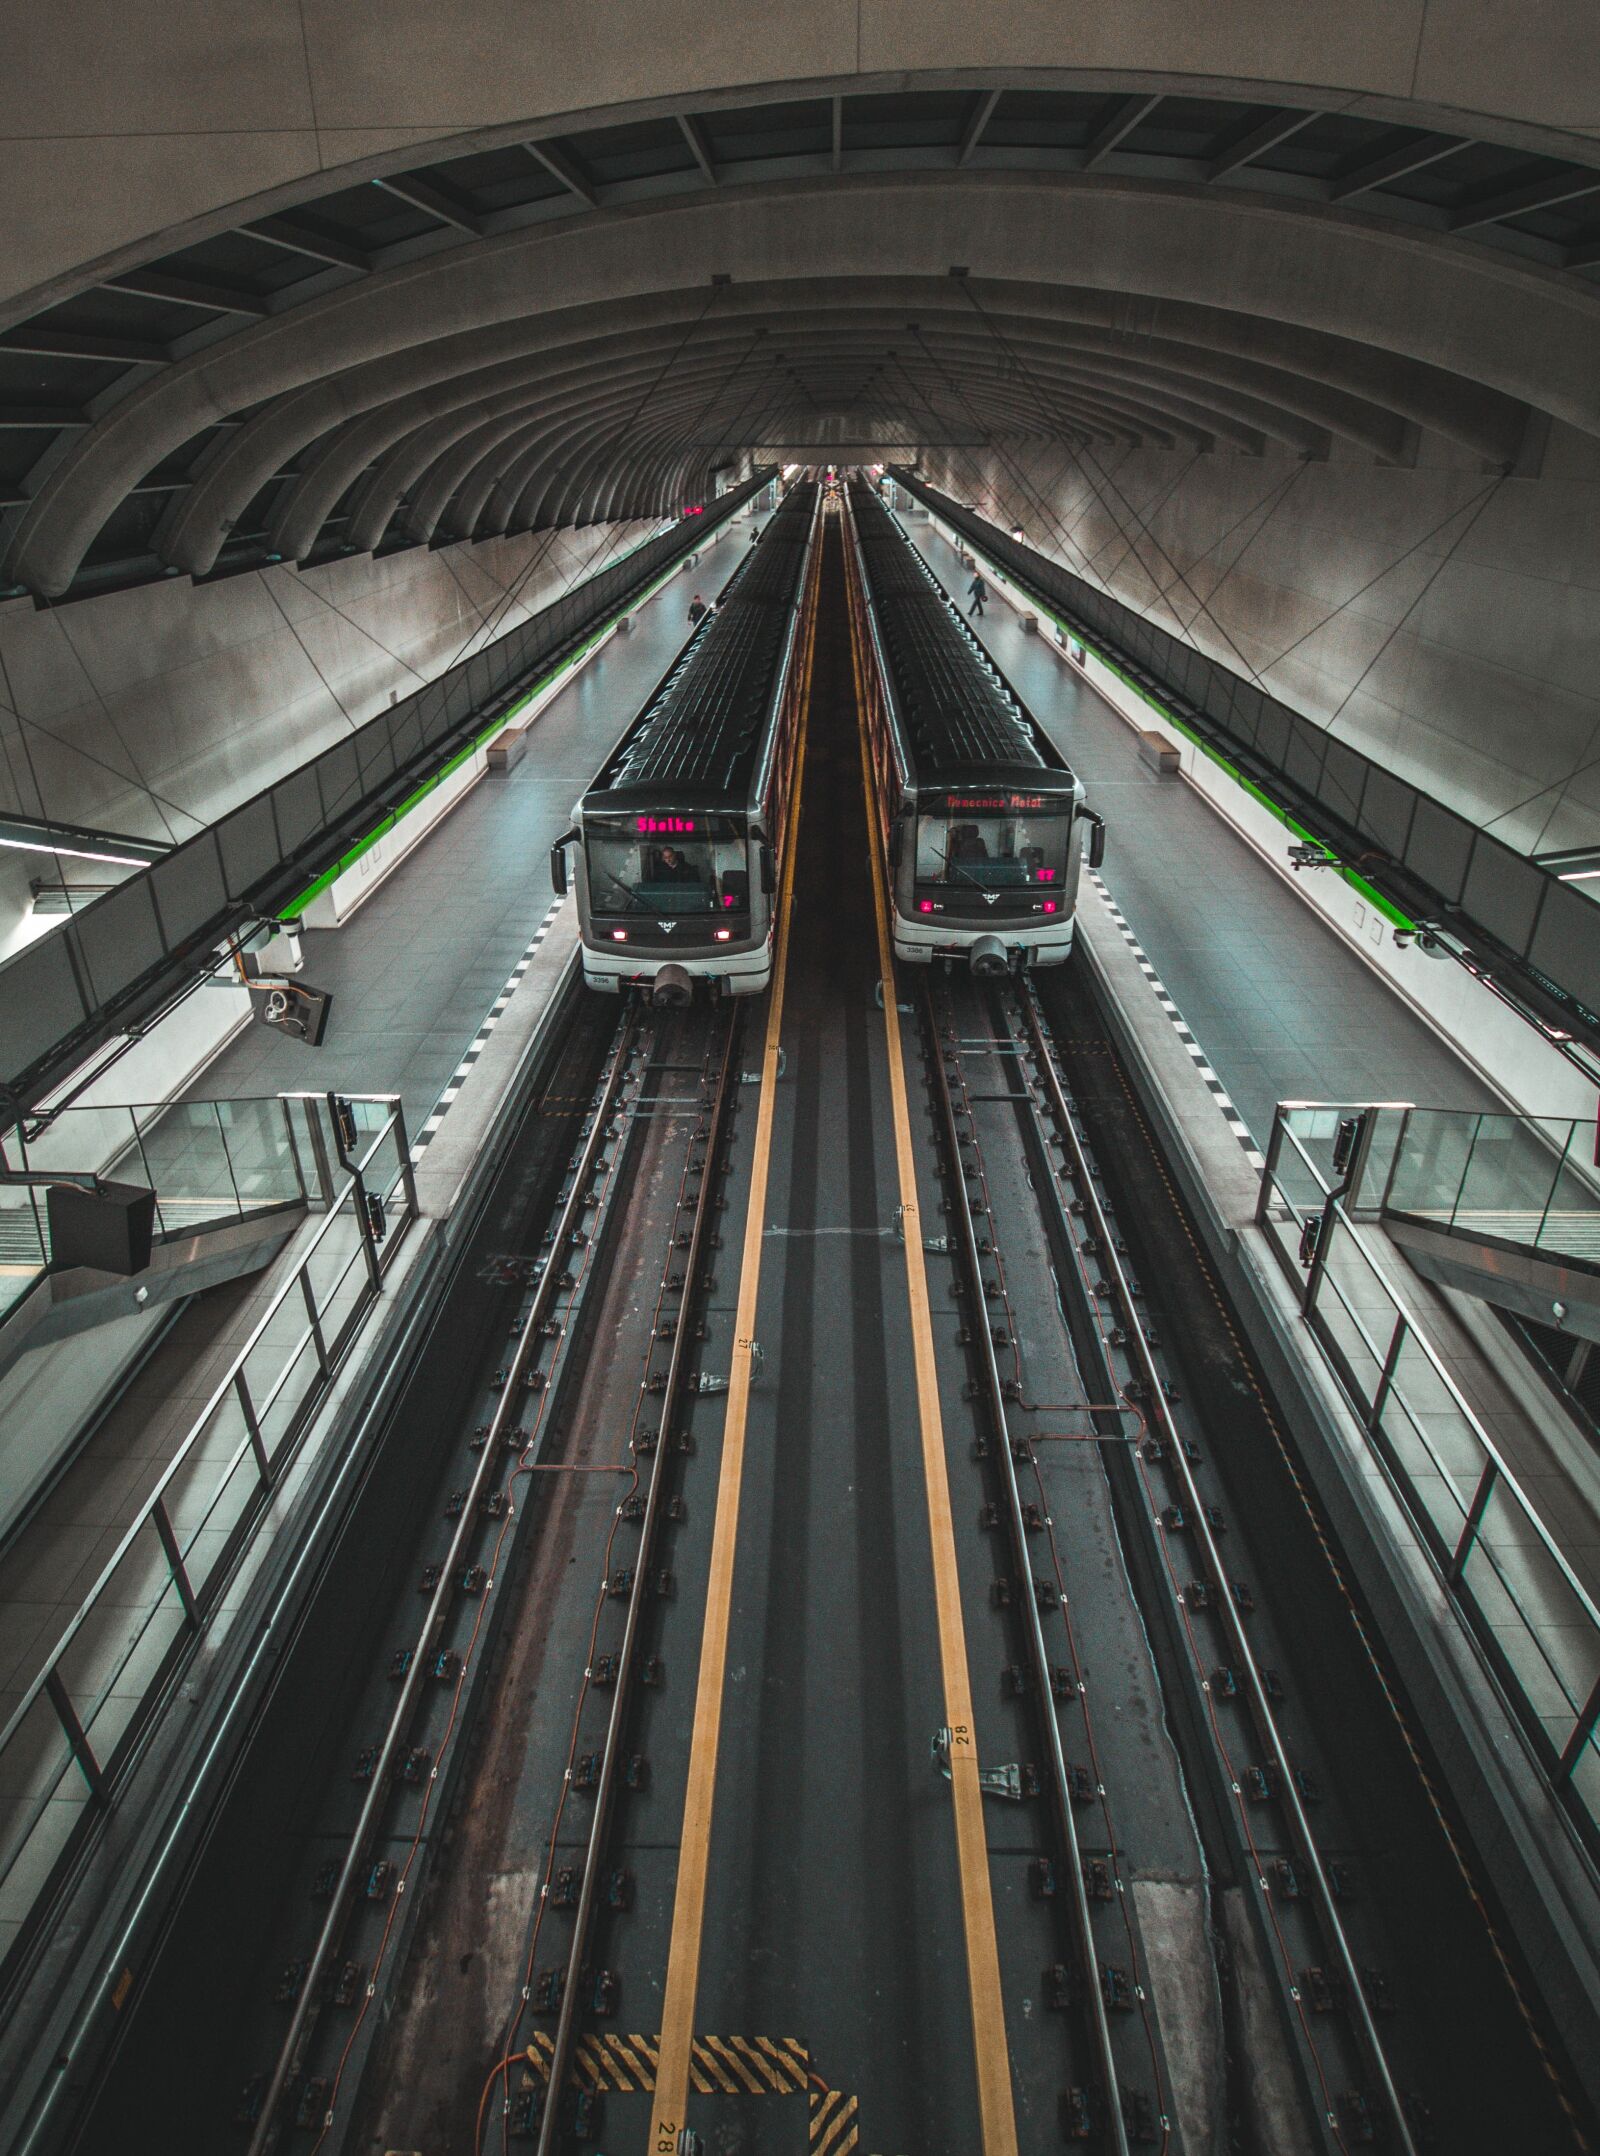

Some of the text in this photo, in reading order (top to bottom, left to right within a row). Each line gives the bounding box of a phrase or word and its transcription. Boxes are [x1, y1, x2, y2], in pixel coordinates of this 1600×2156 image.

[738, 1338, 748, 1349] 27
[955, 1725, 969, 1745] 28
[657, 2121, 676, 2153] 28
